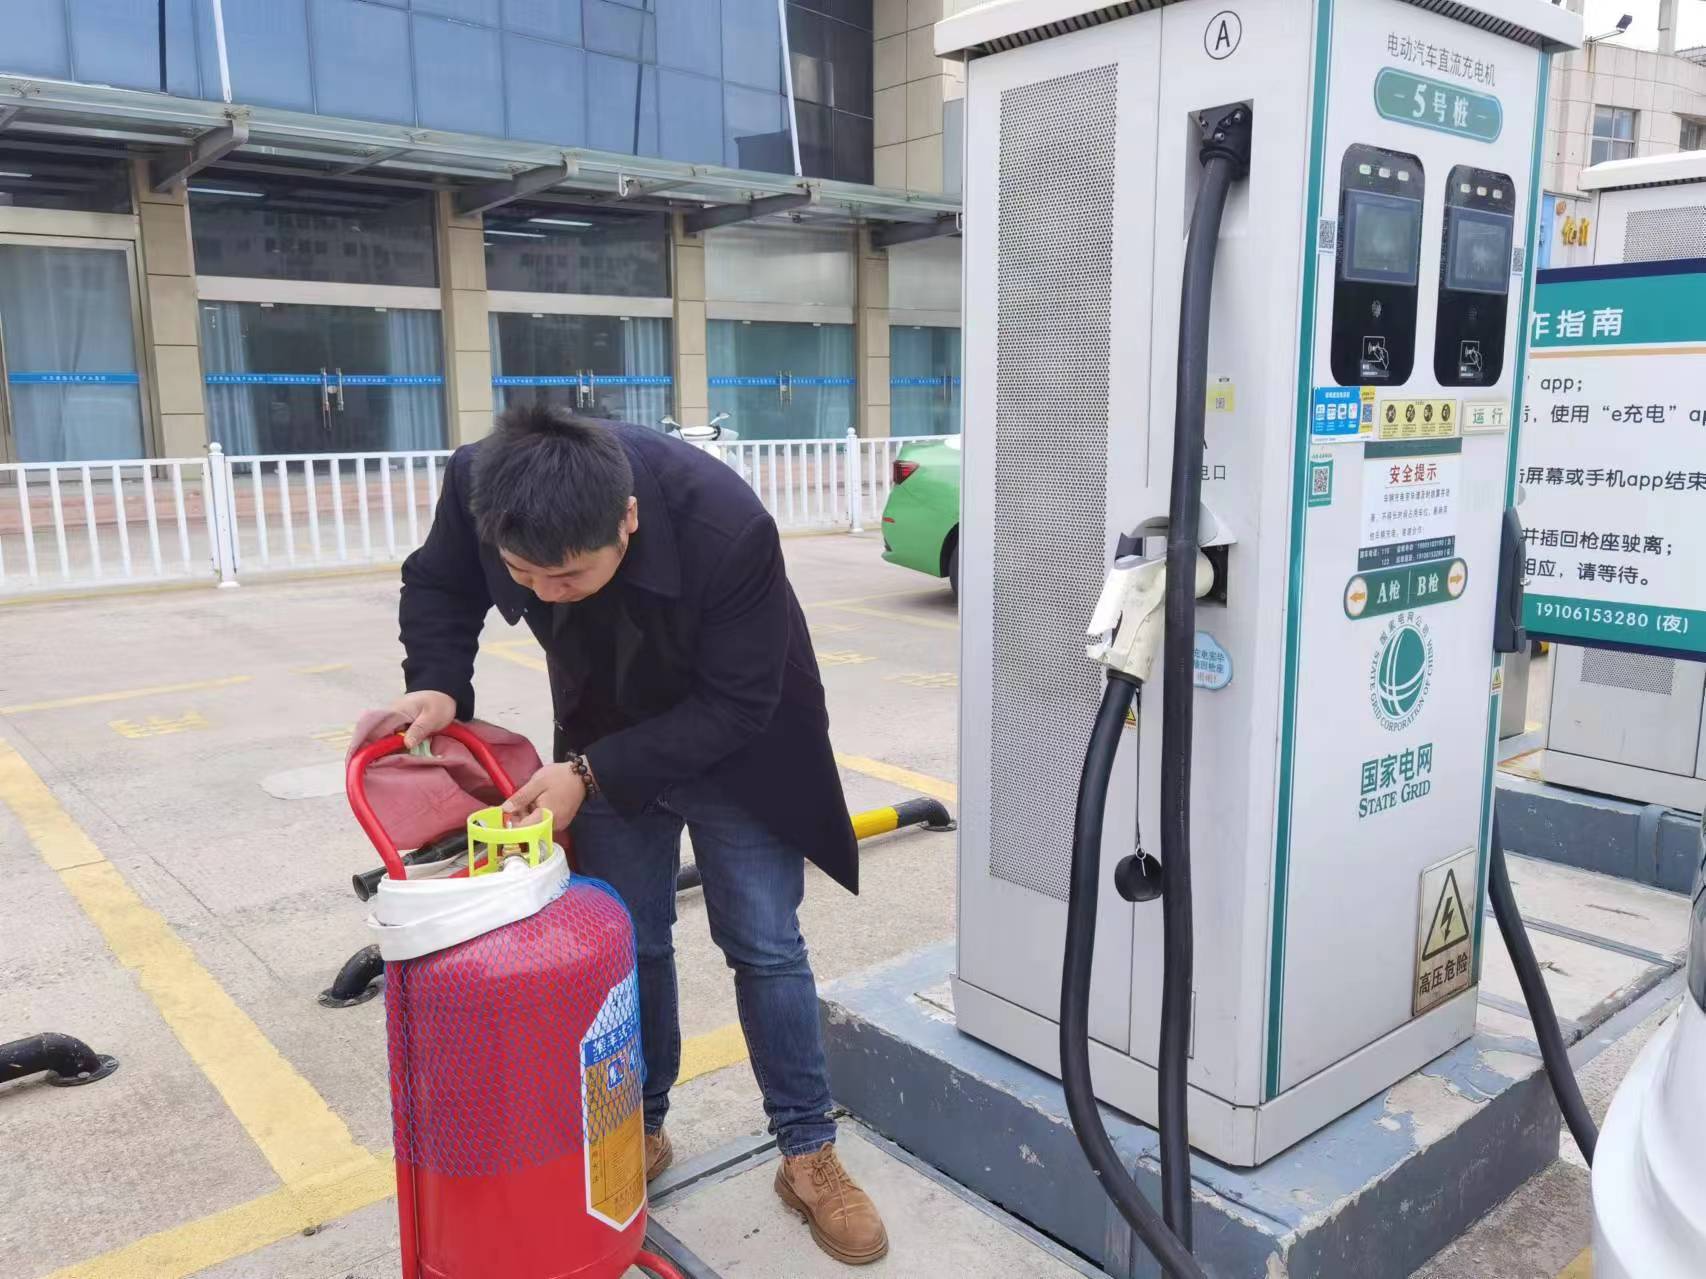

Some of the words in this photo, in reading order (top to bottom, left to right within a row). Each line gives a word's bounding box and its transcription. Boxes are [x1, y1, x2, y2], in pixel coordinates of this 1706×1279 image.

[1215, 20, 1230, 50] A
[1387, 32, 1496, 87] 电动汽车直流充电机
[1412, 83, 1469, 128] 5号桩
[1472, 407, 1504, 425] 运行
[1389, 463, 1438, 485] 安全提示
[1377, 579, 1401, 604] A枪
[1417, 573, 1440, 597] B枪
[1536, 602, 1649, 628] 19106153280
[1360, 743, 1433, 796] 国家电网
[1359, 791, 1397, 819] STATE
[1401, 779, 1431, 804] GRID
[1419, 955, 1469, 994] 高压危险
